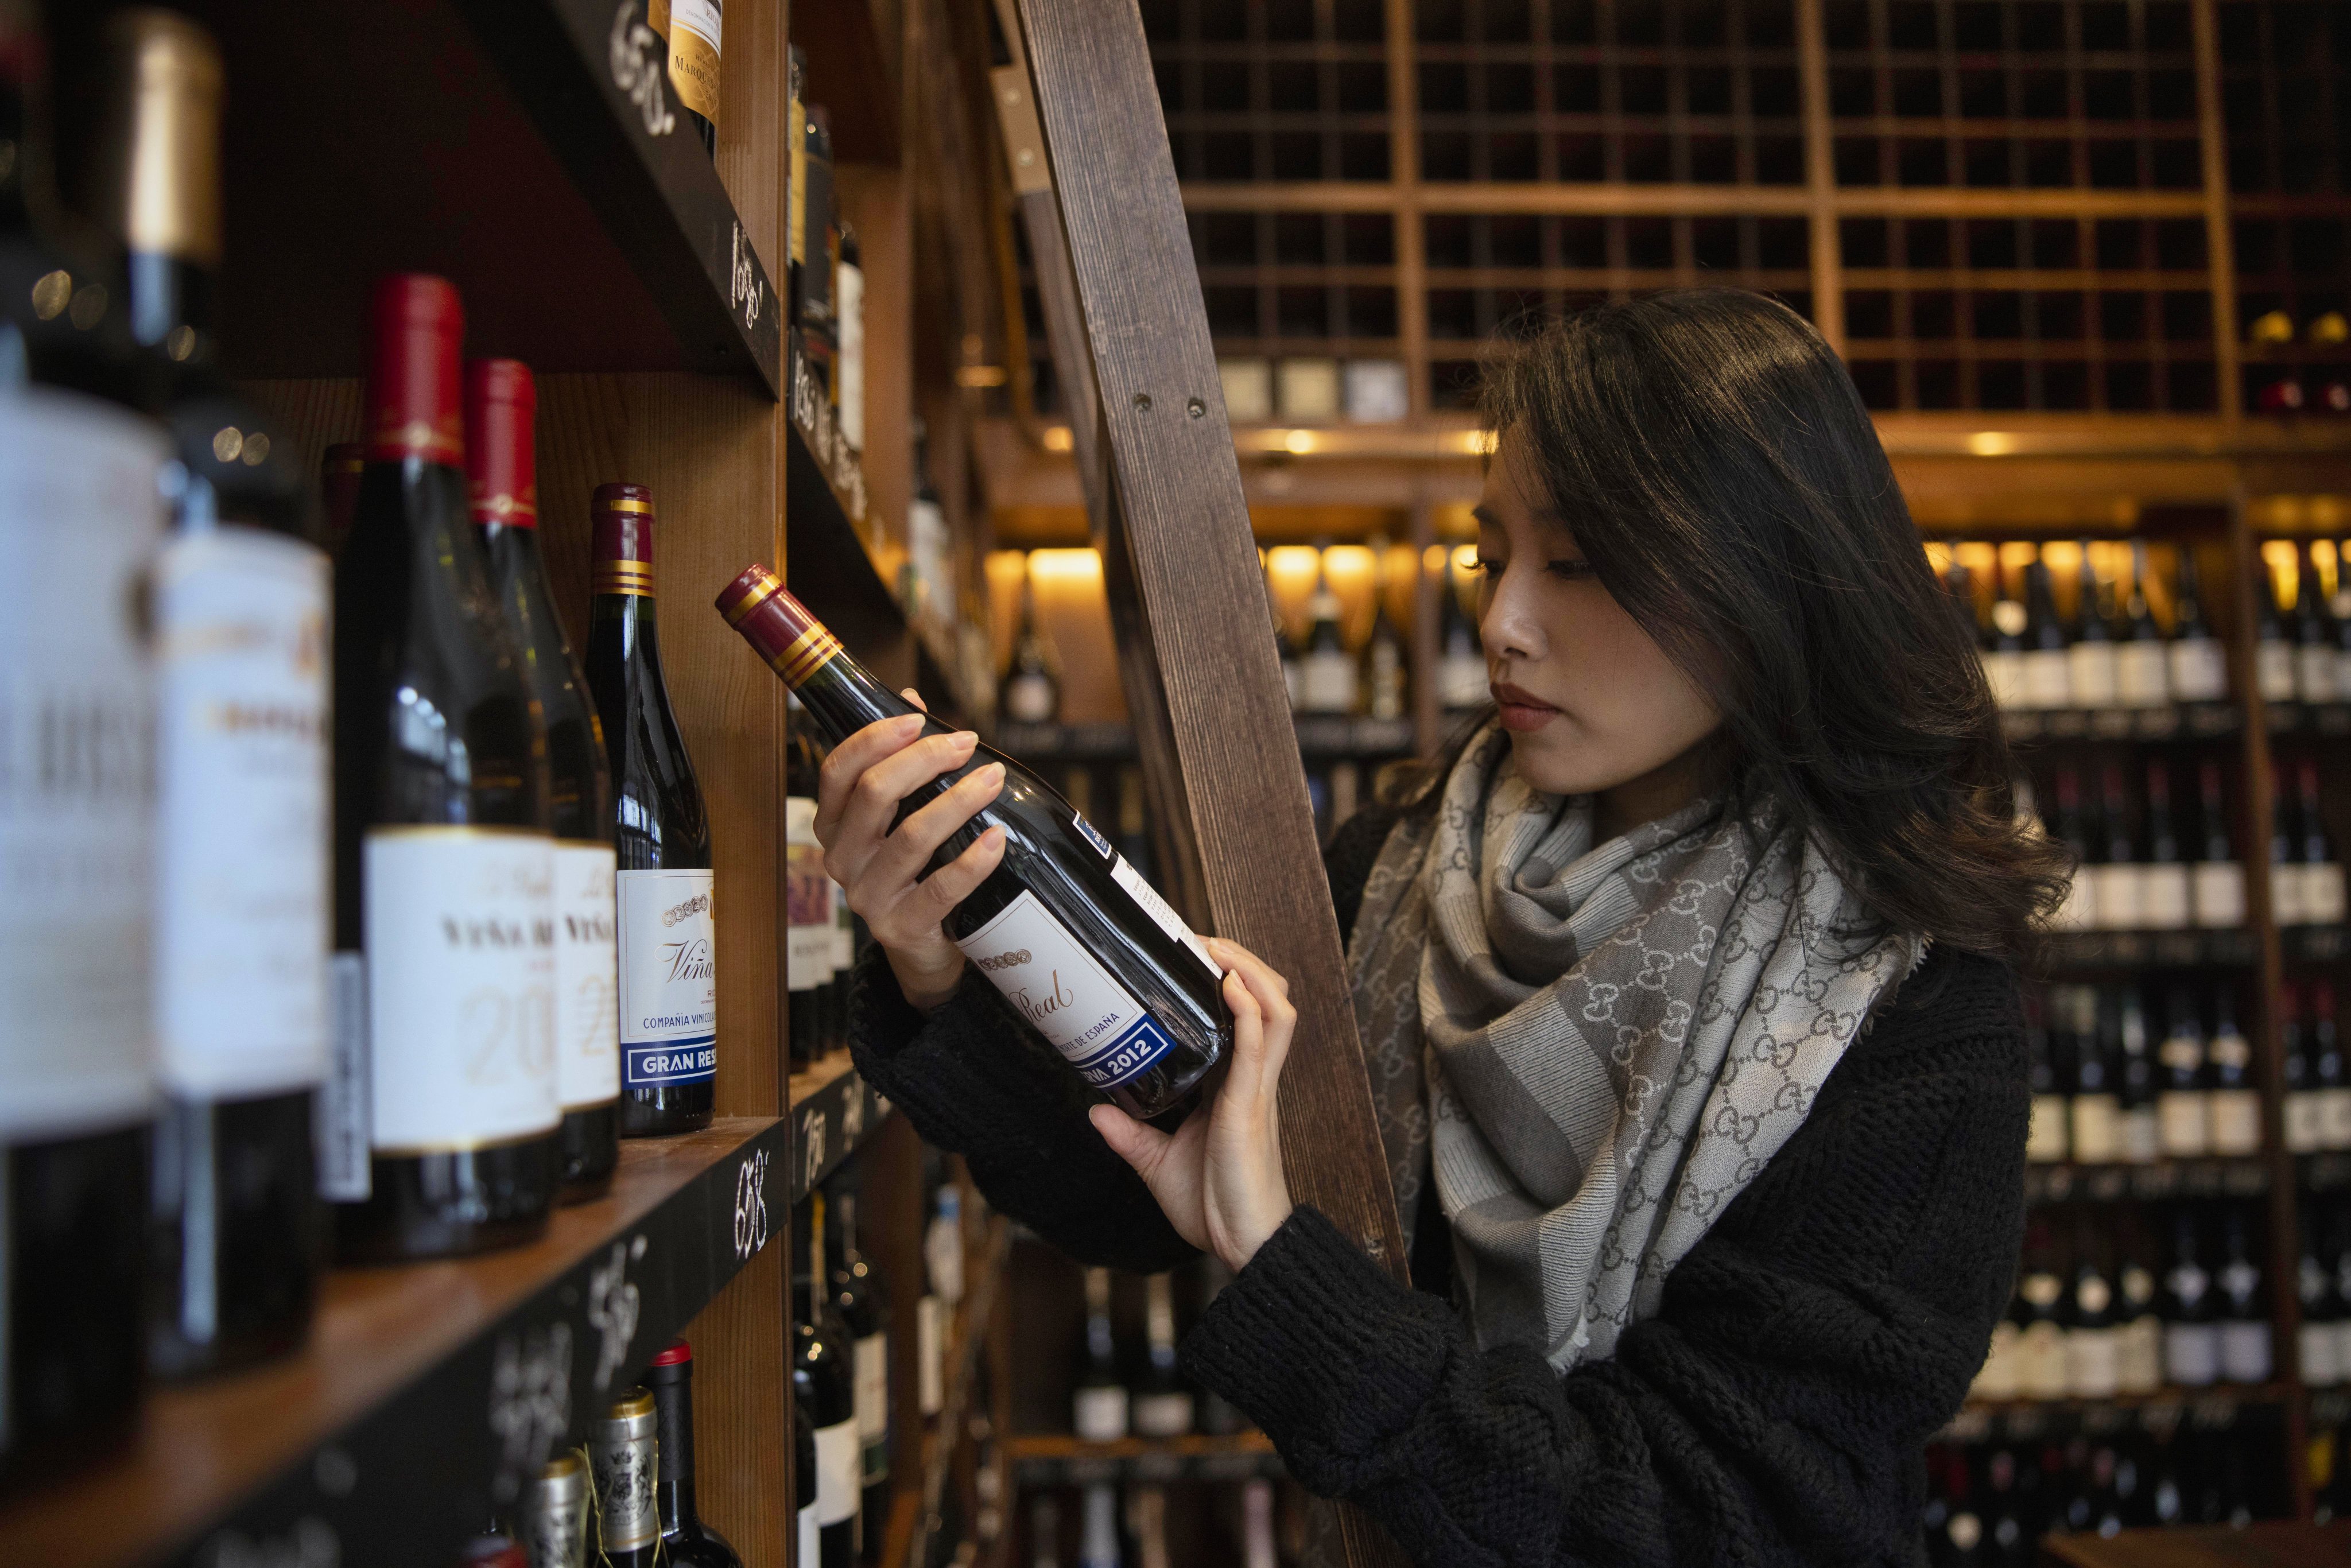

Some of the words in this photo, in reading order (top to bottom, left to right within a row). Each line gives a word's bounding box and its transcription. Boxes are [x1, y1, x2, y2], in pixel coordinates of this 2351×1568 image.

[654, 939, 713, 984] Viña
[1008, 969, 1073, 1023] Real
[1075, 1035, 1088, 1047] DE
[1085, 1013, 1120, 1041] ESPAÑA
[642, 1053, 695, 1074] GRAN
[1107, 1039, 1152, 1076] 2012
